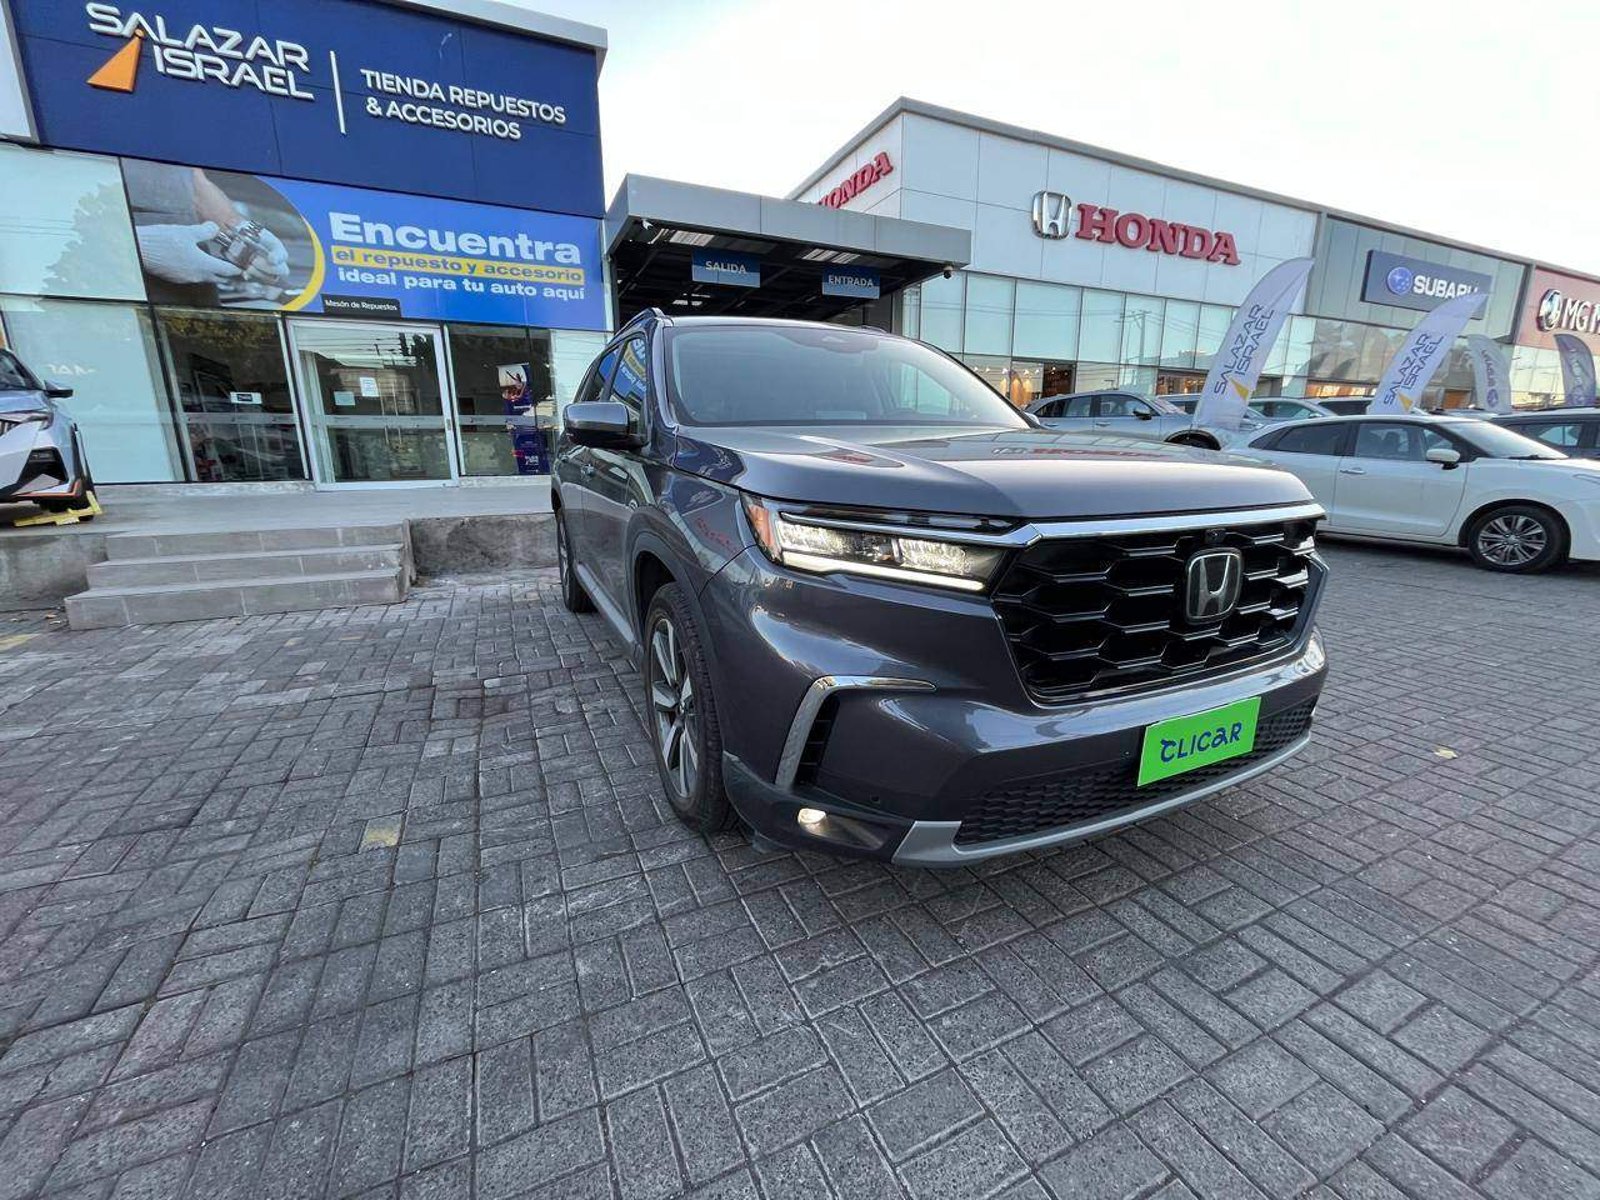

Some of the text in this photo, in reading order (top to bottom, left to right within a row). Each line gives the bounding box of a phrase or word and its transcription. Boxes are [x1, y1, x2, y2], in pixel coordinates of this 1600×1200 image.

[86, 3, 310, 73] SALAZAR
[153, 45, 314, 100] ISRAEL
[360, 68, 566, 124] TIENDA REPUESTOS
[366, 97, 521, 140] & ACCESORIOS
[328, 211, 581, 265] Encuentra
[1075, 204, 1241, 265] HONDA
[335, 250, 582, 282] el repuesto y accesorio
[338, 267, 585, 301] ideal para tu auto aquí
[705, 260, 747, 275] SALIDA
[828, 274, 874, 288] ENTRADA
[361, 302, 398, 311] Repuestos
[1214, 304, 1263, 394] SALAZAR
[1234, 309, 1275, 376] ISRAEL
[1383, 333, 1431, 405] SALAZAR
[1400, 335, 1444, 390] ISRAEL
